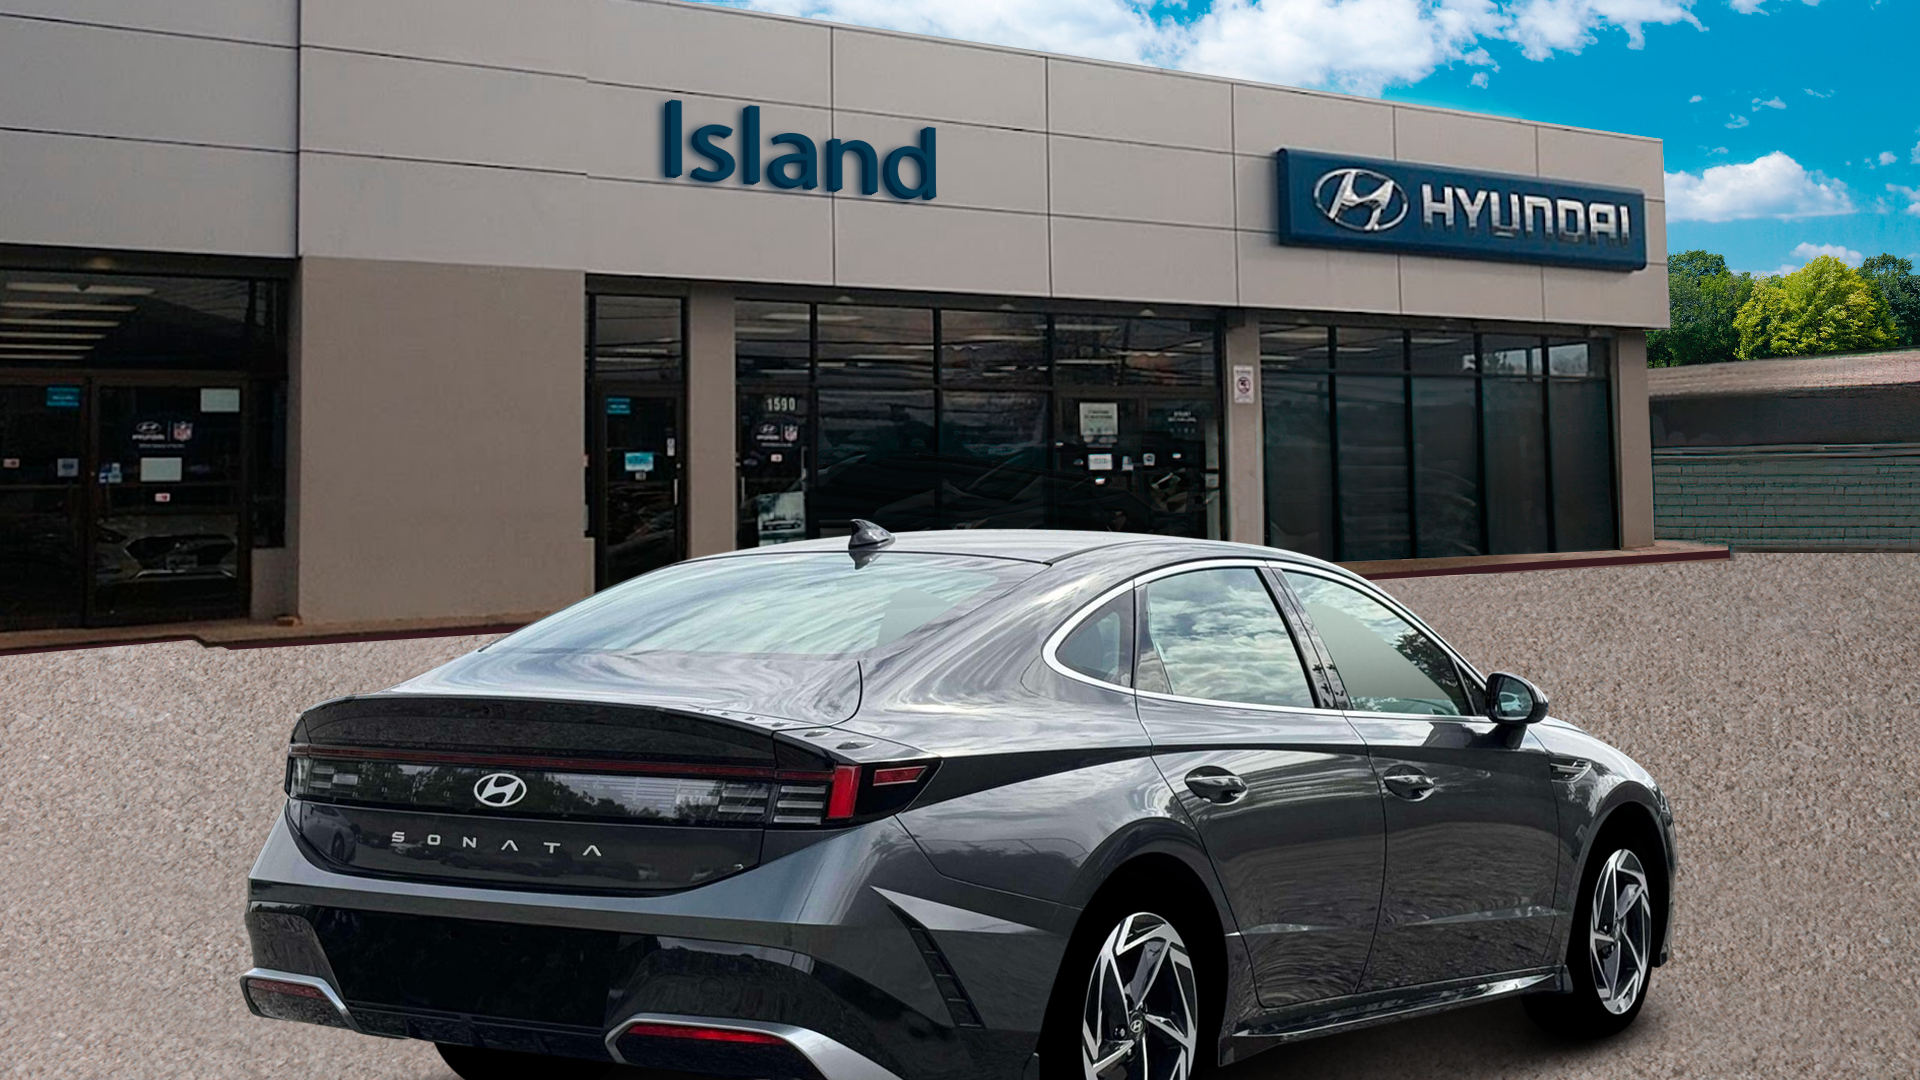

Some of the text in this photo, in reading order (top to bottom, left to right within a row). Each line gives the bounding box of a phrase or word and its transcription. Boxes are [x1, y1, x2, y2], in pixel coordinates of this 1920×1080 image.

[664, 99, 937, 201] Island
[1421, 184, 1630, 240] HYUNDAI
[767, 397, 796, 411] 1590
[391, 831, 602, 857] SONATA
